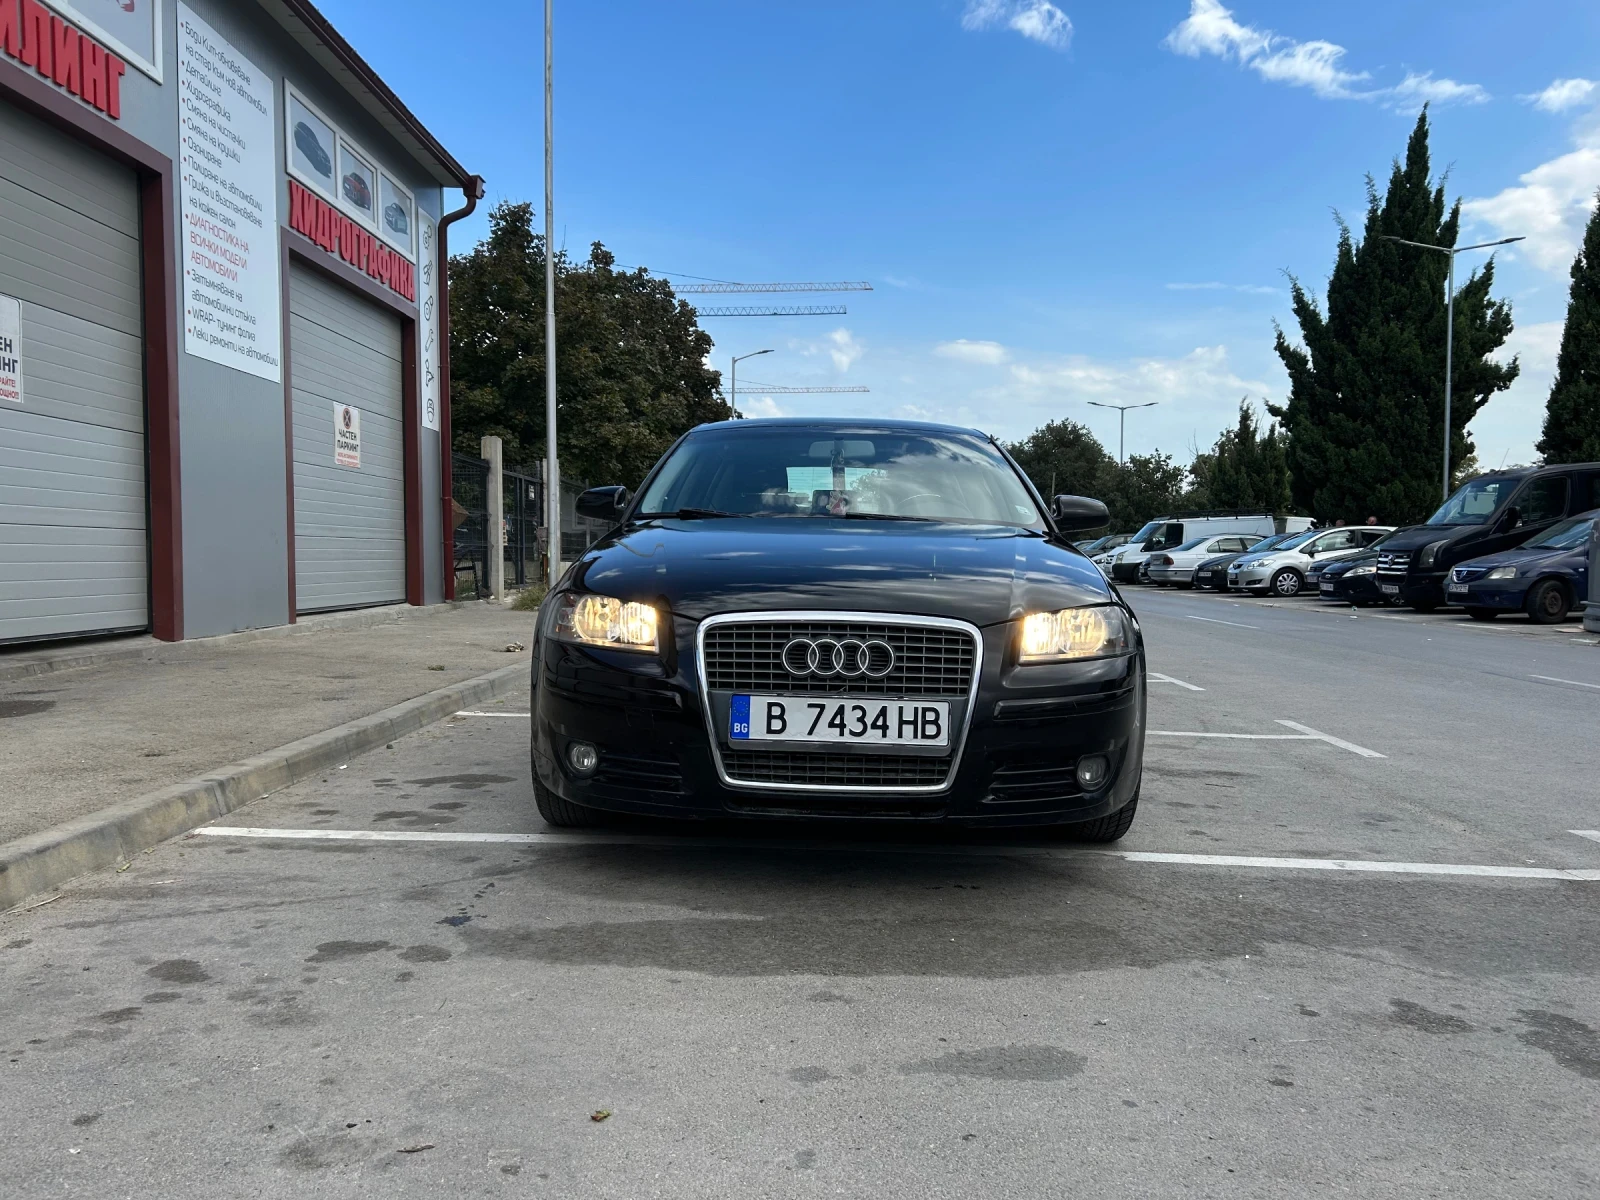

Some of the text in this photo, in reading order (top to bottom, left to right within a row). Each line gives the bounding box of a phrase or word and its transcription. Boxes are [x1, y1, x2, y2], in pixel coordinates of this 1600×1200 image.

[186, 60, 222, 97] Детайлинг
[186, 43, 267, 116] на стар към нов автомобил
[186, 78, 231, 122] Хидрографика
[186, 98, 246, 150] Смяна на чистачки
[187, 117, 241, 163] Смяна на крушки
[187, 136, 222, 168] Озониране
[188, 155, 263, 212] Полиране на автомобили
[188, 174, 209, 197] Грижа
[210, 189, 215, 200] и
[189, 196, 236, 229] на кожен салон
[189, 213, 250, 254] ДИАГНОСТИКА НА
[190, 231, 247, 270] ВСИЧКИ МОДЕЛИ
[288, 180, 415, 302] ХИДРОГРАФИКА
[190, 250, 238, 282] АВТОМОБИЛИ
[191, 269, 242, 303] Затъмняване на
[192, 289, 256, 325] автомобилни стъкла
[192, 326, 279, 366] Леки ремонти на автомобили
[733, 722, 748, 733] BG
[766, 701, 788, 735] B
[806, 703, 890, 738] 7434
